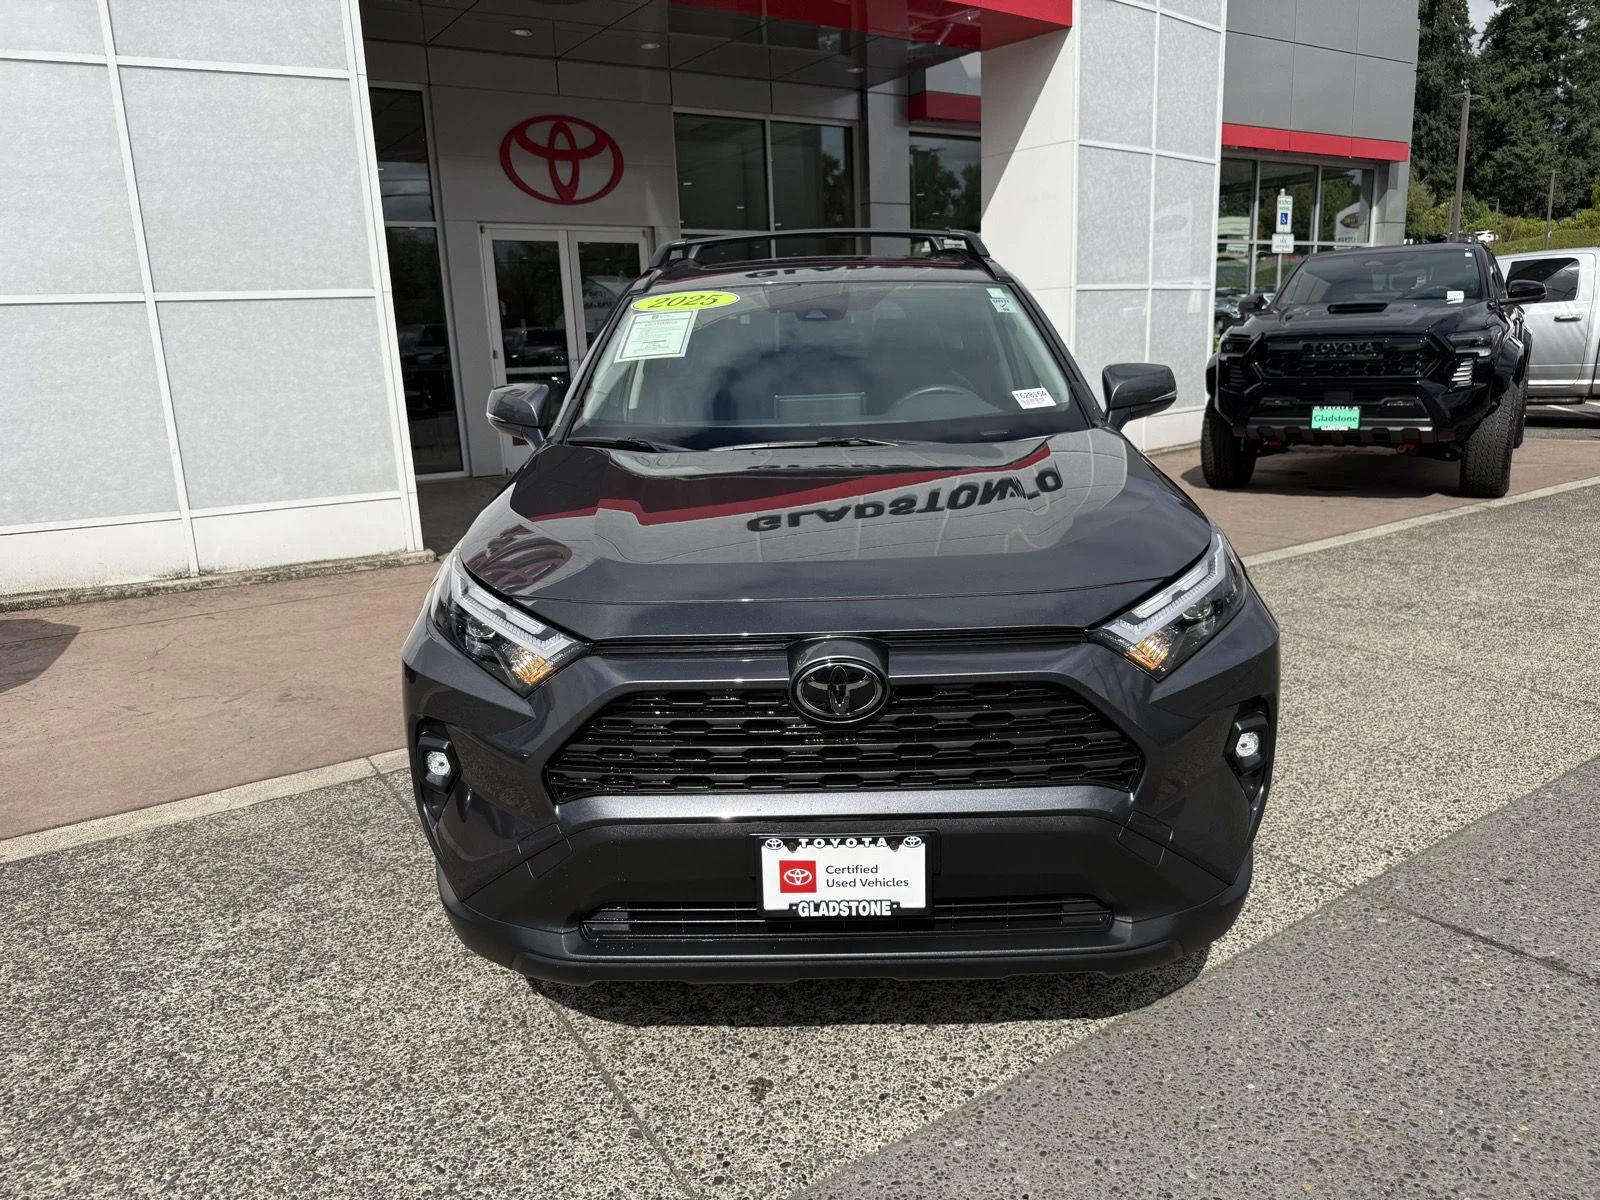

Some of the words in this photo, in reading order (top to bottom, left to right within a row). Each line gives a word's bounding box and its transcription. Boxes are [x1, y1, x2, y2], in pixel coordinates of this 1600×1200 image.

[648, 294, 723, 309] 2025
[1311, 342, 1375, 353] TOYOTA
[1313, 414, 1358, 423] Gladstone
[798, 837, 888, 849] TOYOTA
[825, 864, 879, 875] Certified
[826, 878, 857, 888] Used
[860, 877, 909, 888] Vehicles
[798, 900, 892, 917] GLADSTONE
